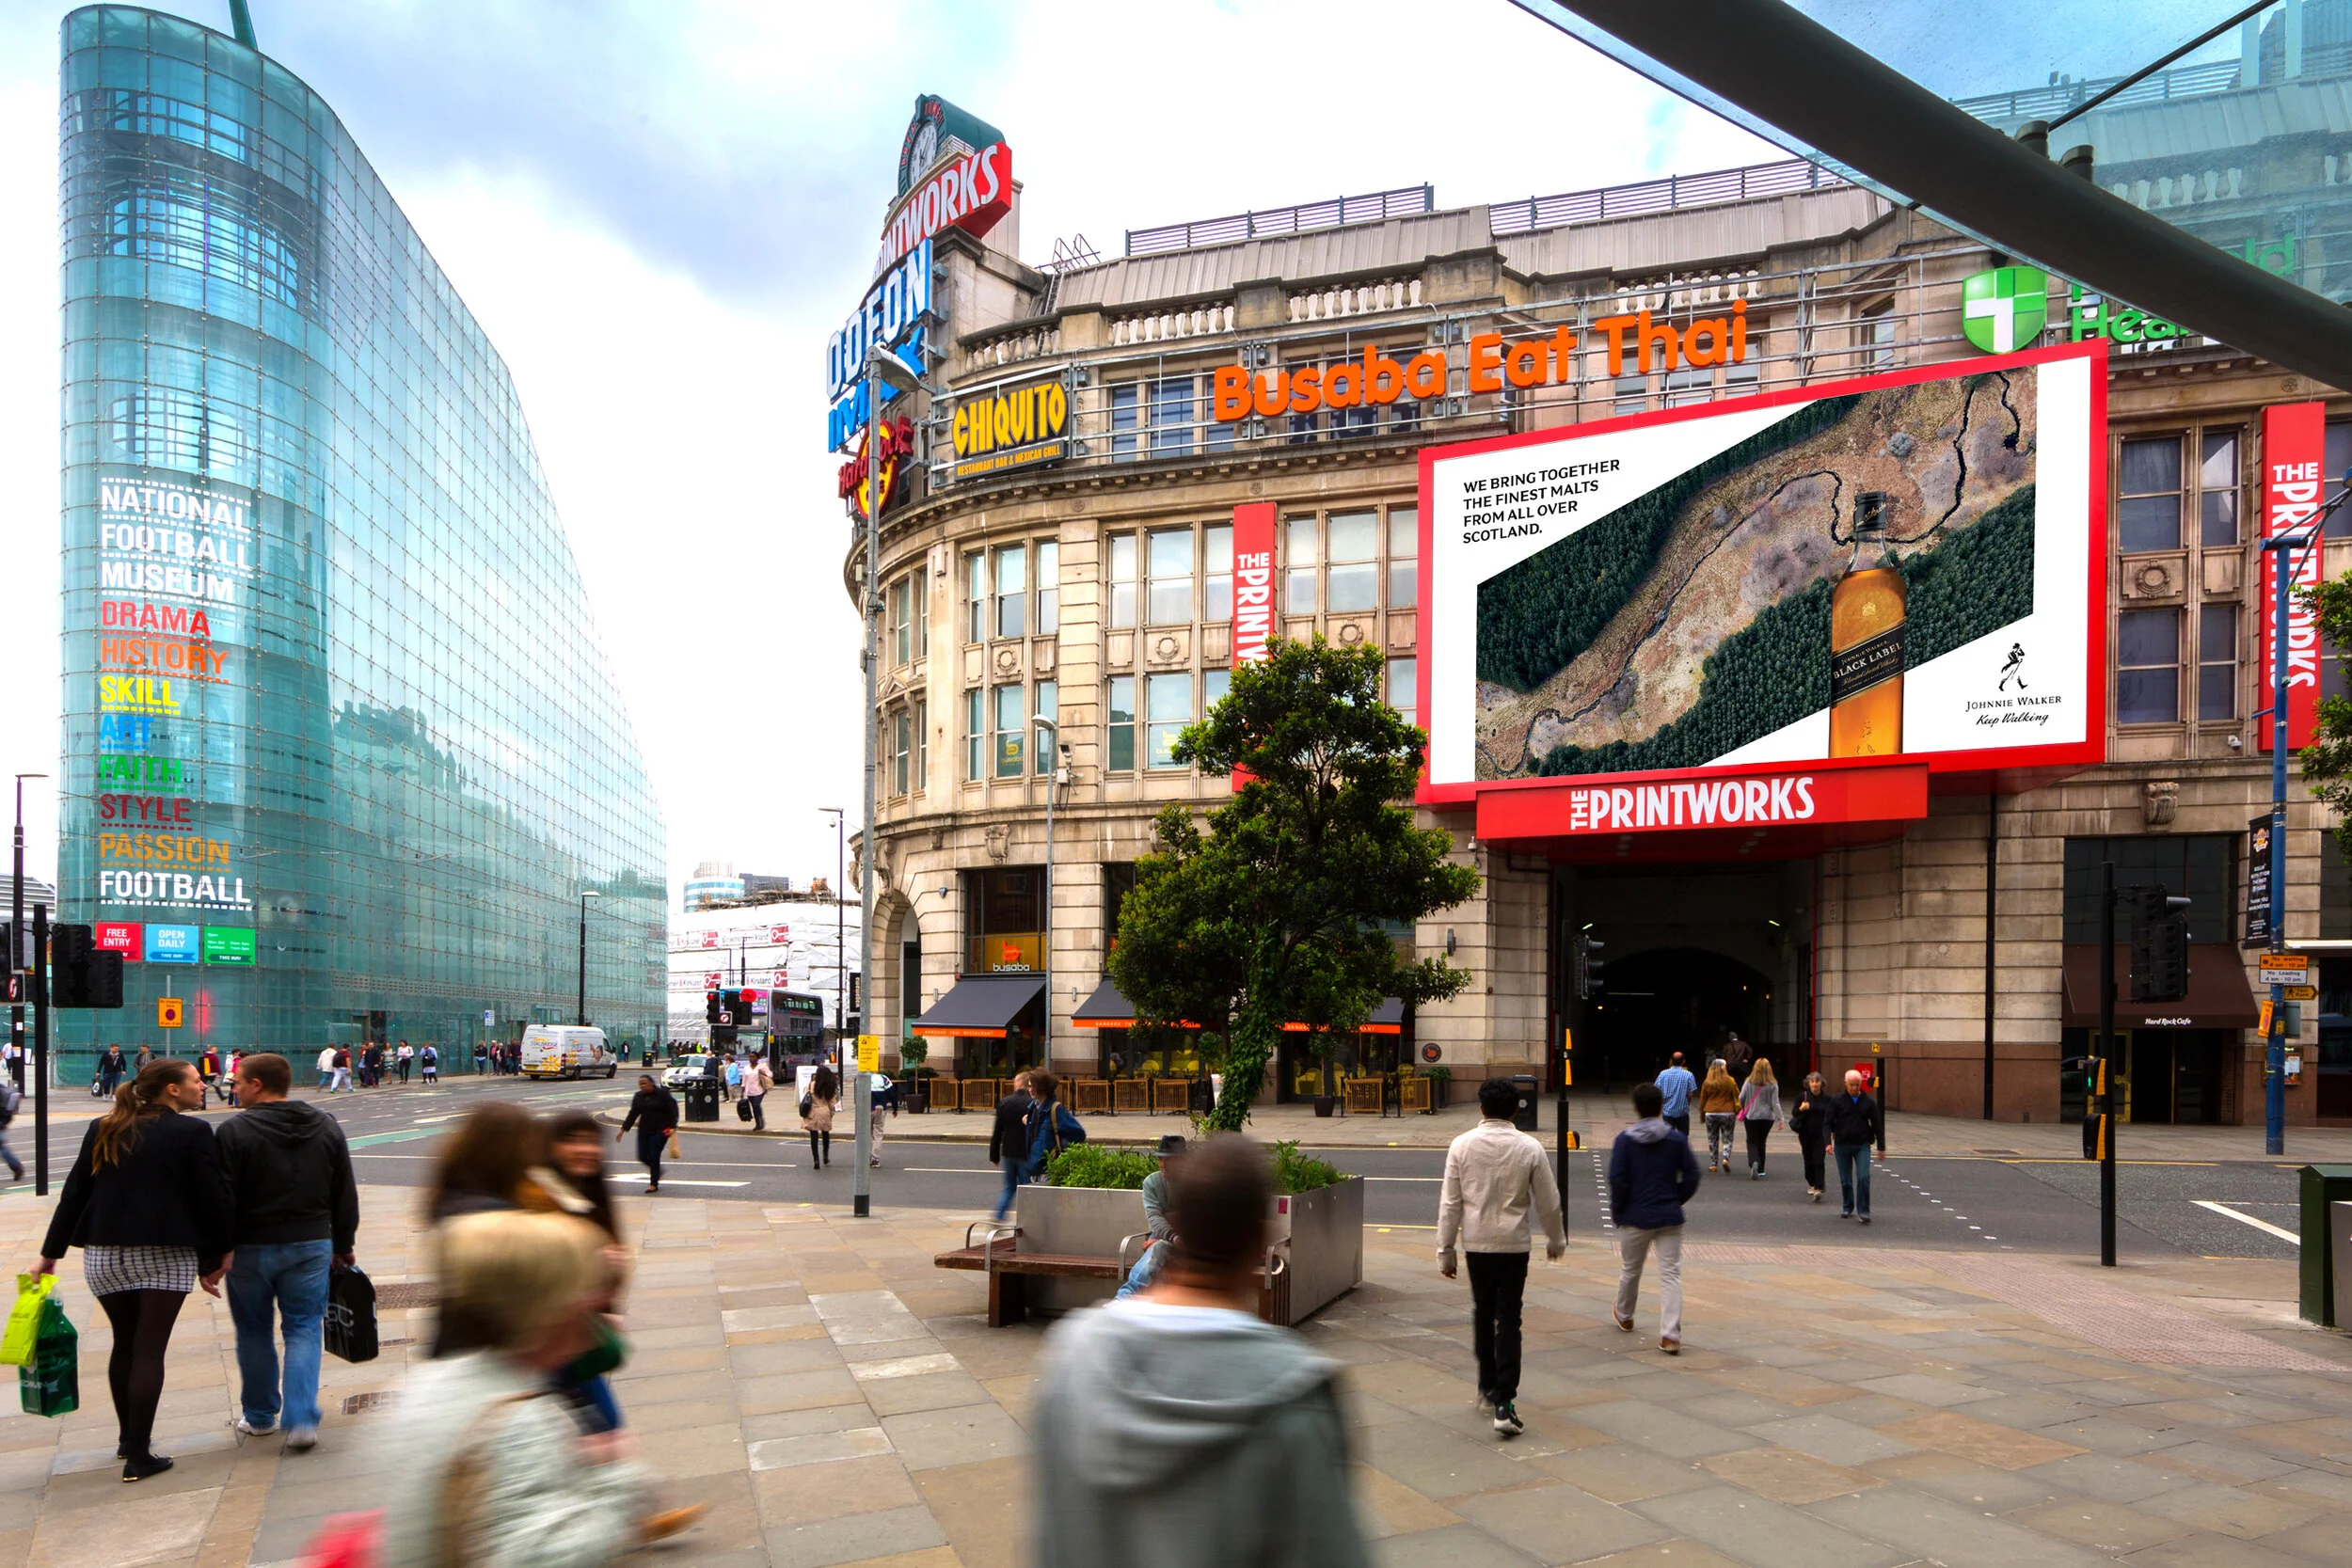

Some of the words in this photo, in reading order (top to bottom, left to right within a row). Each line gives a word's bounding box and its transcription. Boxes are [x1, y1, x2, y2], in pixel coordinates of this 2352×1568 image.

[827, 238, 932, 400] ODEON
[1214, 344, 1446, 421] Busaba
[1470, 325, 1577, 394] Eat
[1595, 299, 1748, 376] Thai
[952, 382, 1066, 455] CHIQUITO
[957, 459, 994, 476] RESTAURANT
[995, 454, 1008, 468] BAR
[1015, 448, 1042, 464] MEXICAN
[1043, 444, 1060, 458] GRILL
[2273, 462, 2318, 483] THE
[1463, 480, 1486, 493] WE
[1490, 472, 1536, 490] BRING
[1539, 459, 1620, 482] TOGETHER
[102, 484, 251, 533] NATIONAL
[1463, 496, 1492, 510] THE
[1496, 487, 1548, 505] FINEST
[1550, 480, 1598, 498] MALTS
[1463, 511, 1503, 527] FROM
[1507, 507, 1534, 521] ALL
[1537, 500, 1578, 515] OVER
[102, 523, 253, 571] FOOTBALL
[1463, 523, 1542, 544] SCOTLAND.
[1237, 552, 1269, 568] THE
[102, 561, 234, 603] MUSEUM
[102, 600, 212, 637] DRAMA
[102, 639, 229, 674] HISTORY
[1833, 658, 1867, 679] BLACK
[1868, 642, 1902, 663] LABEL
[101, 675, 179, 706] SKILL
[1965, 699, 2013, 712] JOHNNIE
[2017, 695, 2061, 705] WALKER
[100, 715, 154, 743] ART
[1976, 714, 1999, 728] Keep
[2001, 712, 2049, 726] Walking
[100, 755, 182, 784] FAITH
[101, 794, 192, 823] STYLE
[1570, 790, 1588, 830] THE
[1590, 777, 1815, 830] PRINTWORKS
[100, 832, 230, 864] PASSION
[100, 870, 251, 904] FOOTBALL
[103, 938, 131, 947] ENTRY
[106, 928, 128, 938] FREE
[158, 929, 185, 939] OPEN
[158, 939, 185, 948] DAILY
[993, 963, 1030, 972] busaba
